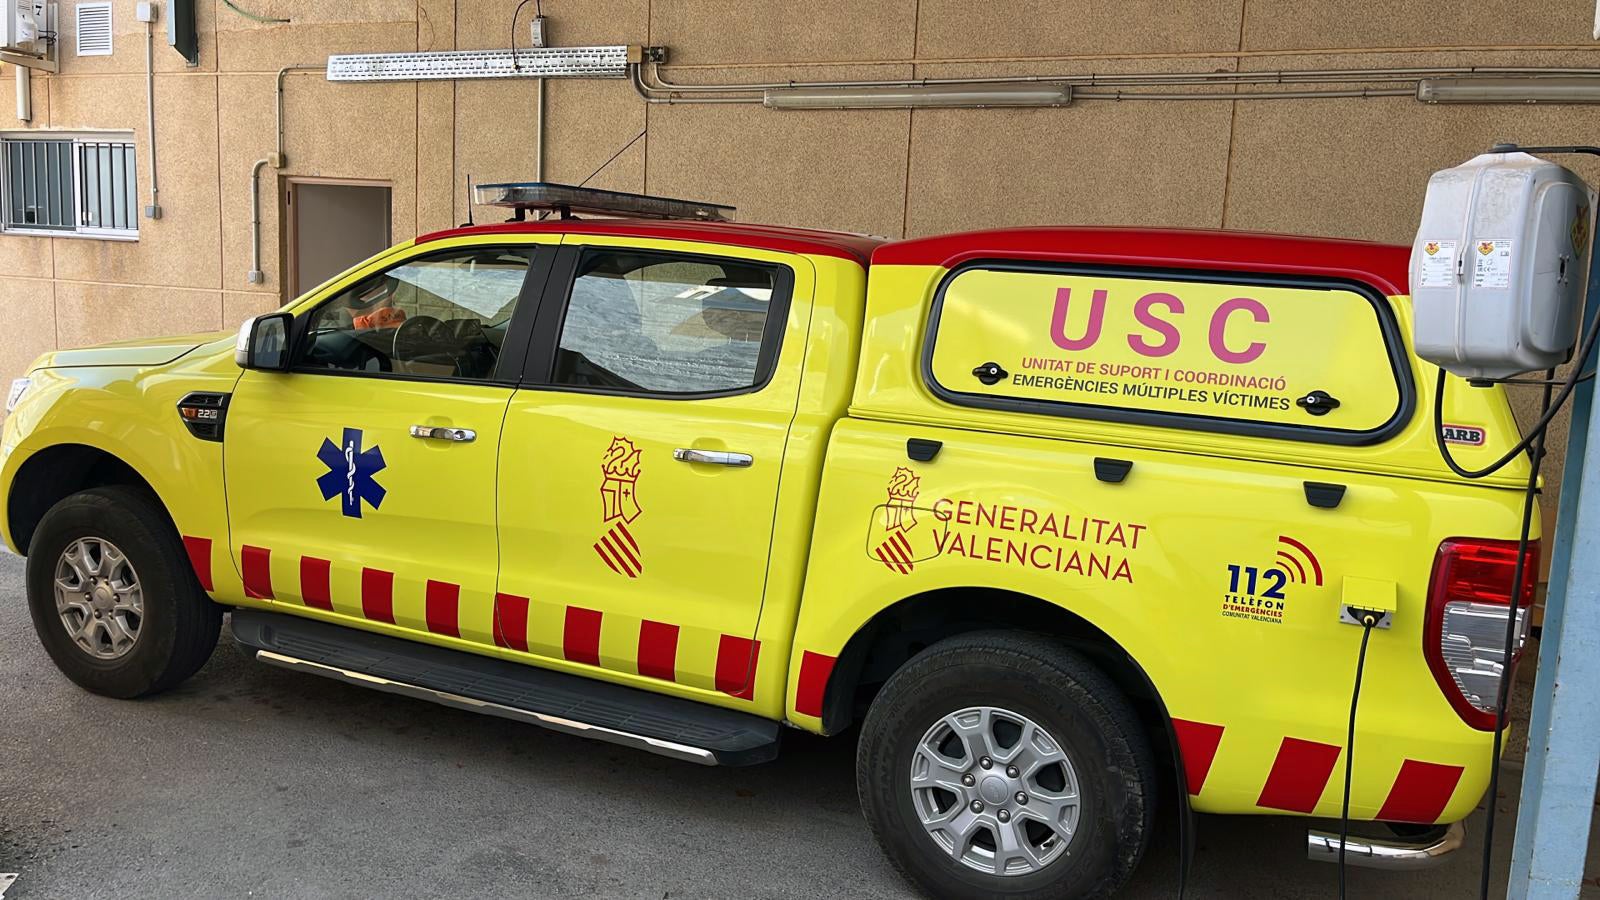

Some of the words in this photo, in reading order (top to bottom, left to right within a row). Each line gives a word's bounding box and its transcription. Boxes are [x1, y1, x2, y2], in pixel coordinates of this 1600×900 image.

[1050, 287, 1271, 364] USC
[1012, 374, 1119, 394] EMERGÈNCIES
[1122, 382, 1208, 403] MÚLTIPLES
[1213, 390, 1290, 410] VÍCTIMES
[1022, 357, 1073, 372] UNITAT
[1076, 361, 1096, 375] DE
[1100, 363, 1162, 380] SUPORT
[1164, 369, 1170, 381] I
[1174, 369, 1286, 391] COORDINACIÓ
[1443, 428, 1480, 442] ARB
[933, 498, 1147, 550] GENERALITAT
[932, 529, 1134, 584] VALENCIANA
[1227, 564, 1287, 600] 112
[1222, 611, 1250, 619] COMUNITAT
[1251, 615, 1282, 624] VALENCIANA
